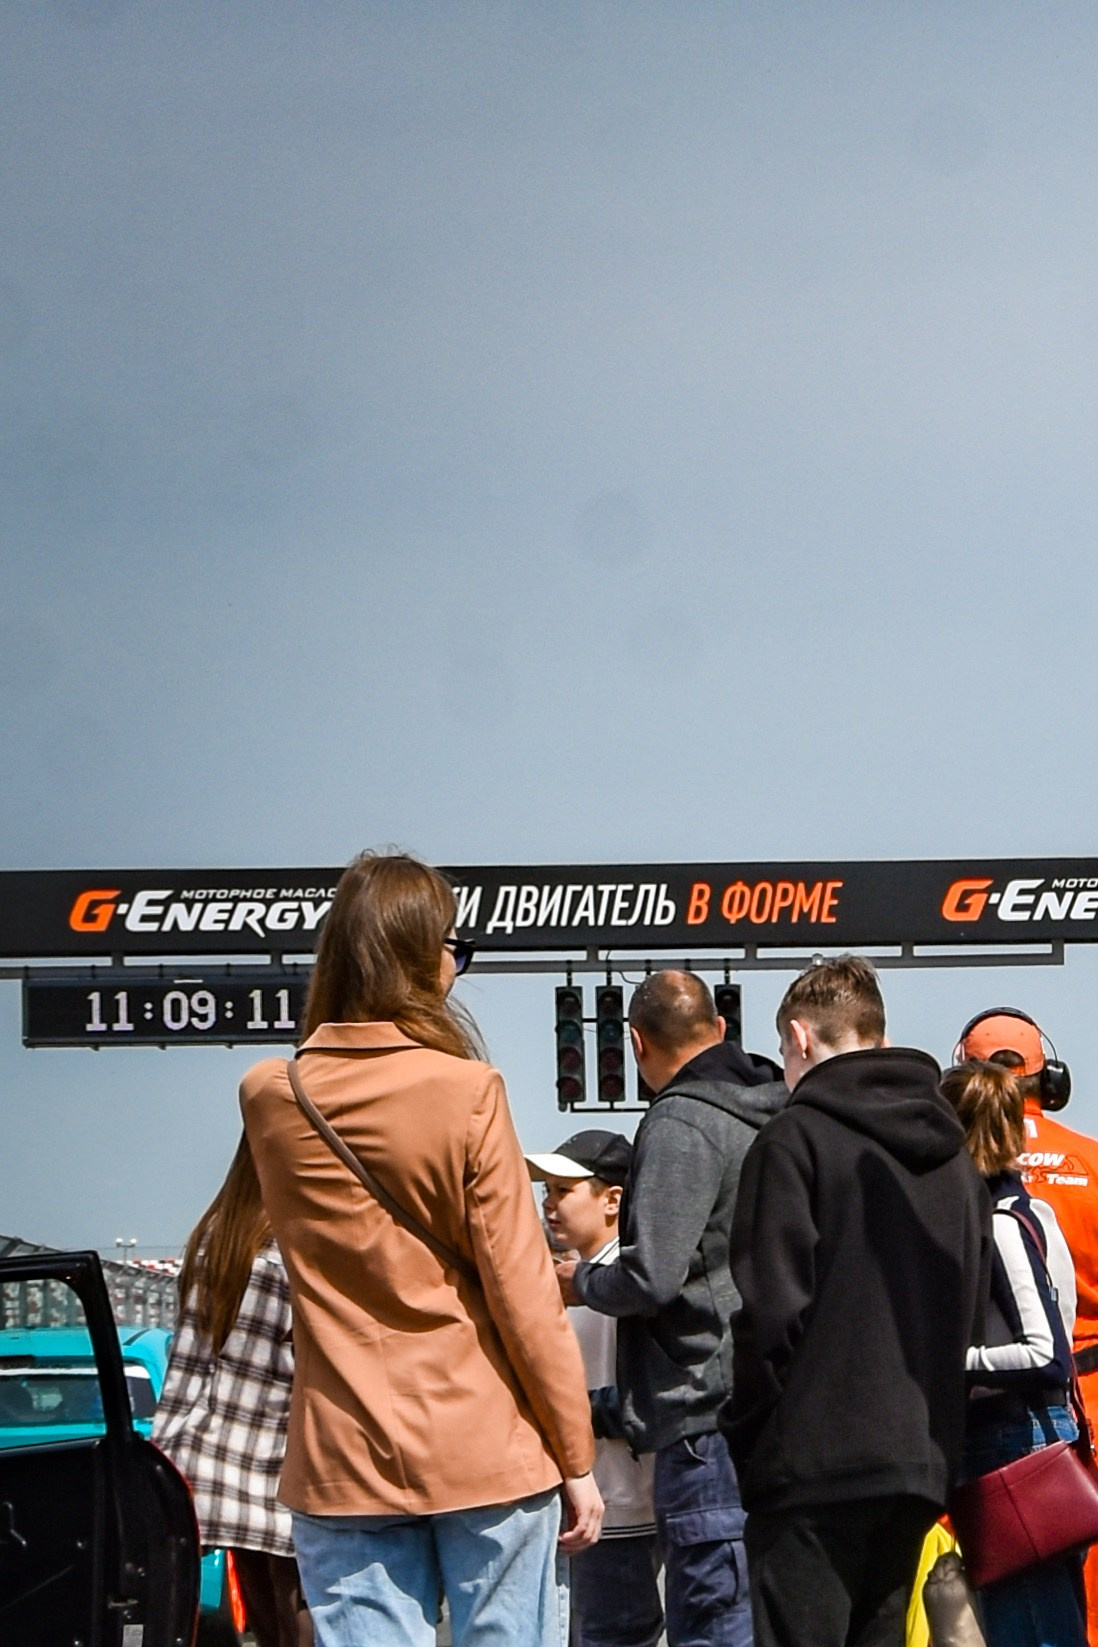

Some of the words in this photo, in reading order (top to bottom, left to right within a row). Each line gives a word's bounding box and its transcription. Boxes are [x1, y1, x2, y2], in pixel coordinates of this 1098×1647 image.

[180, 888, 278, 899] МОТОРНОЕ
[485, 883, 676, 935] ДВИГАТЕЛЬ
[687, 882, 710, 925] В
[721, 880, 843, 924] ФОРМЕ
[85, 989, 296, 1031] 11:09:11
